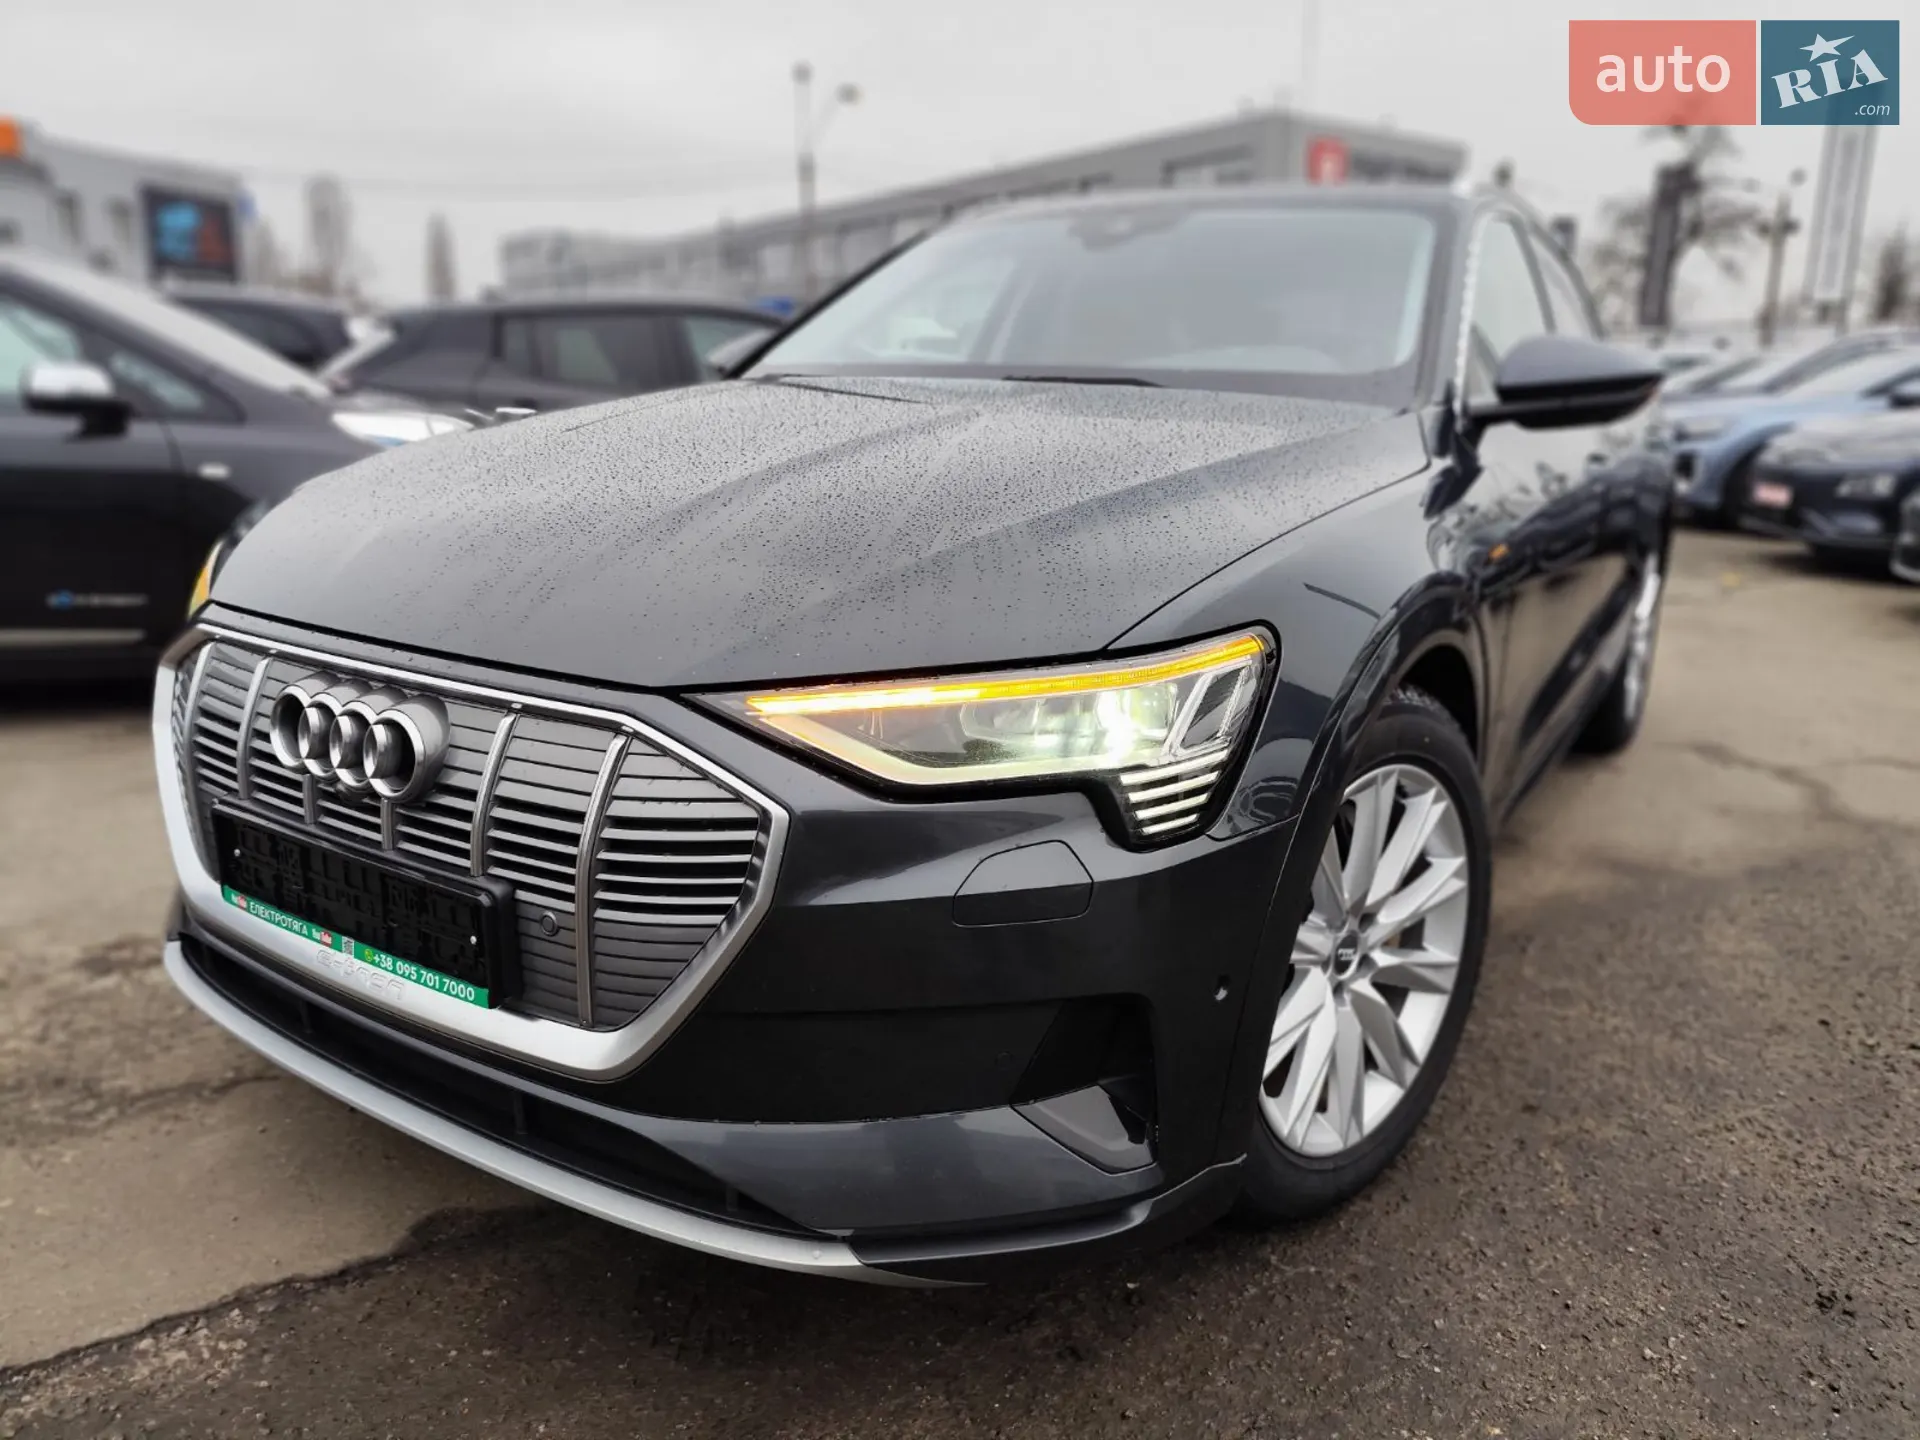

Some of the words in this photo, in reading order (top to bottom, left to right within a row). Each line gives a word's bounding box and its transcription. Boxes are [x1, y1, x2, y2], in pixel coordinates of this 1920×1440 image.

[249, 901, 309, 935] ЕЛЕКТРОТЯГА
[373, 953, 394, 971] +38
[396, 961, 417, 980] 095
[420, 970, 440, 989] 701
[442, 978, 475, 1001] 7000
